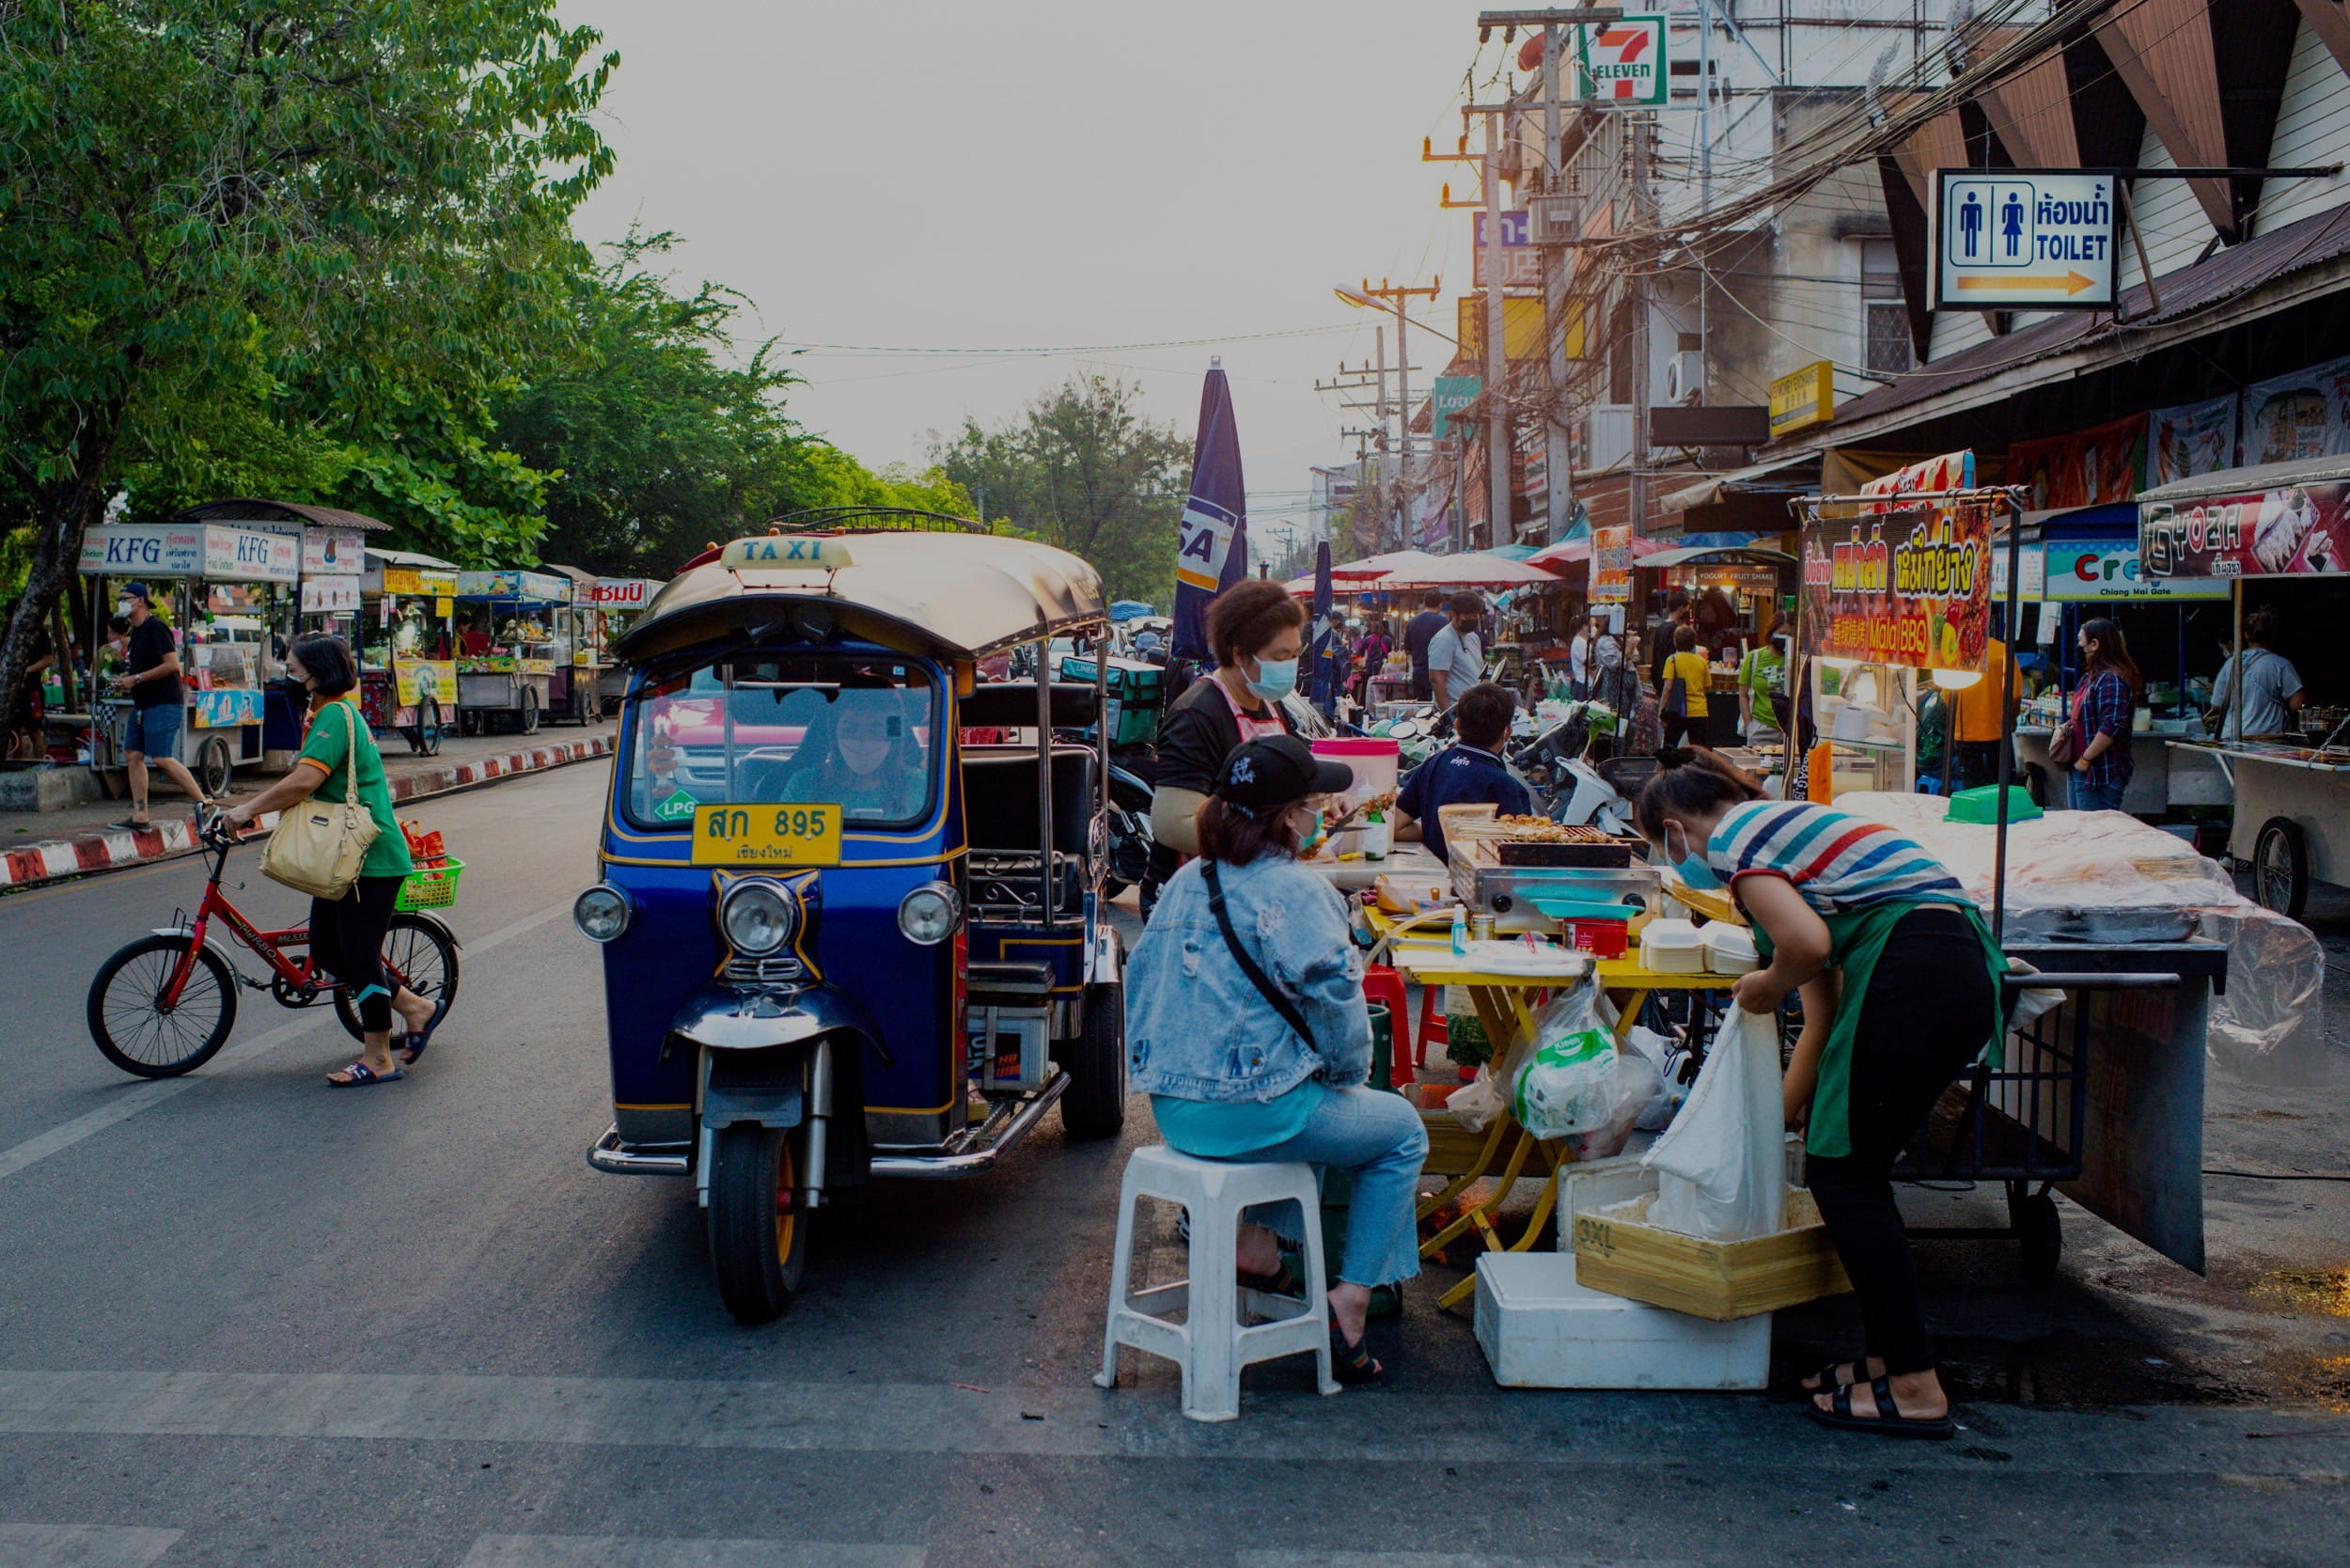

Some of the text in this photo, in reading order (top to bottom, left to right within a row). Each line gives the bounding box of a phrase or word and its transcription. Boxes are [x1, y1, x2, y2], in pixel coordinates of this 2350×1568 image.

[1600, 30, 1649, 98] 7
[2036, 184, 2108, 225] ห้องน้ำ
[2036, 235, 2107, 260] TOILET
[1438, 395, 1474, 409] Lotu
[106, 537, 162, 563] KFG
[238, 535, 269, 564] KFG
[744, 541, 822, 560] TAXI
[2147, 503, 2243, 576] GYOZA
[1700, 572, 1775, 581] YOGURT FRUIT SHAKE
[2100, 588, 2171, 598] Chiang Mai Gate
[1869, 617, 1927, 653] Mala BBQ
[664, 801, 697, 816] LPG
[709, 809, 826, 837] สก 895
[736, 842, 795, 859] เชียงใหม่
[1578, 1218, 1616, 1250] 3XL
